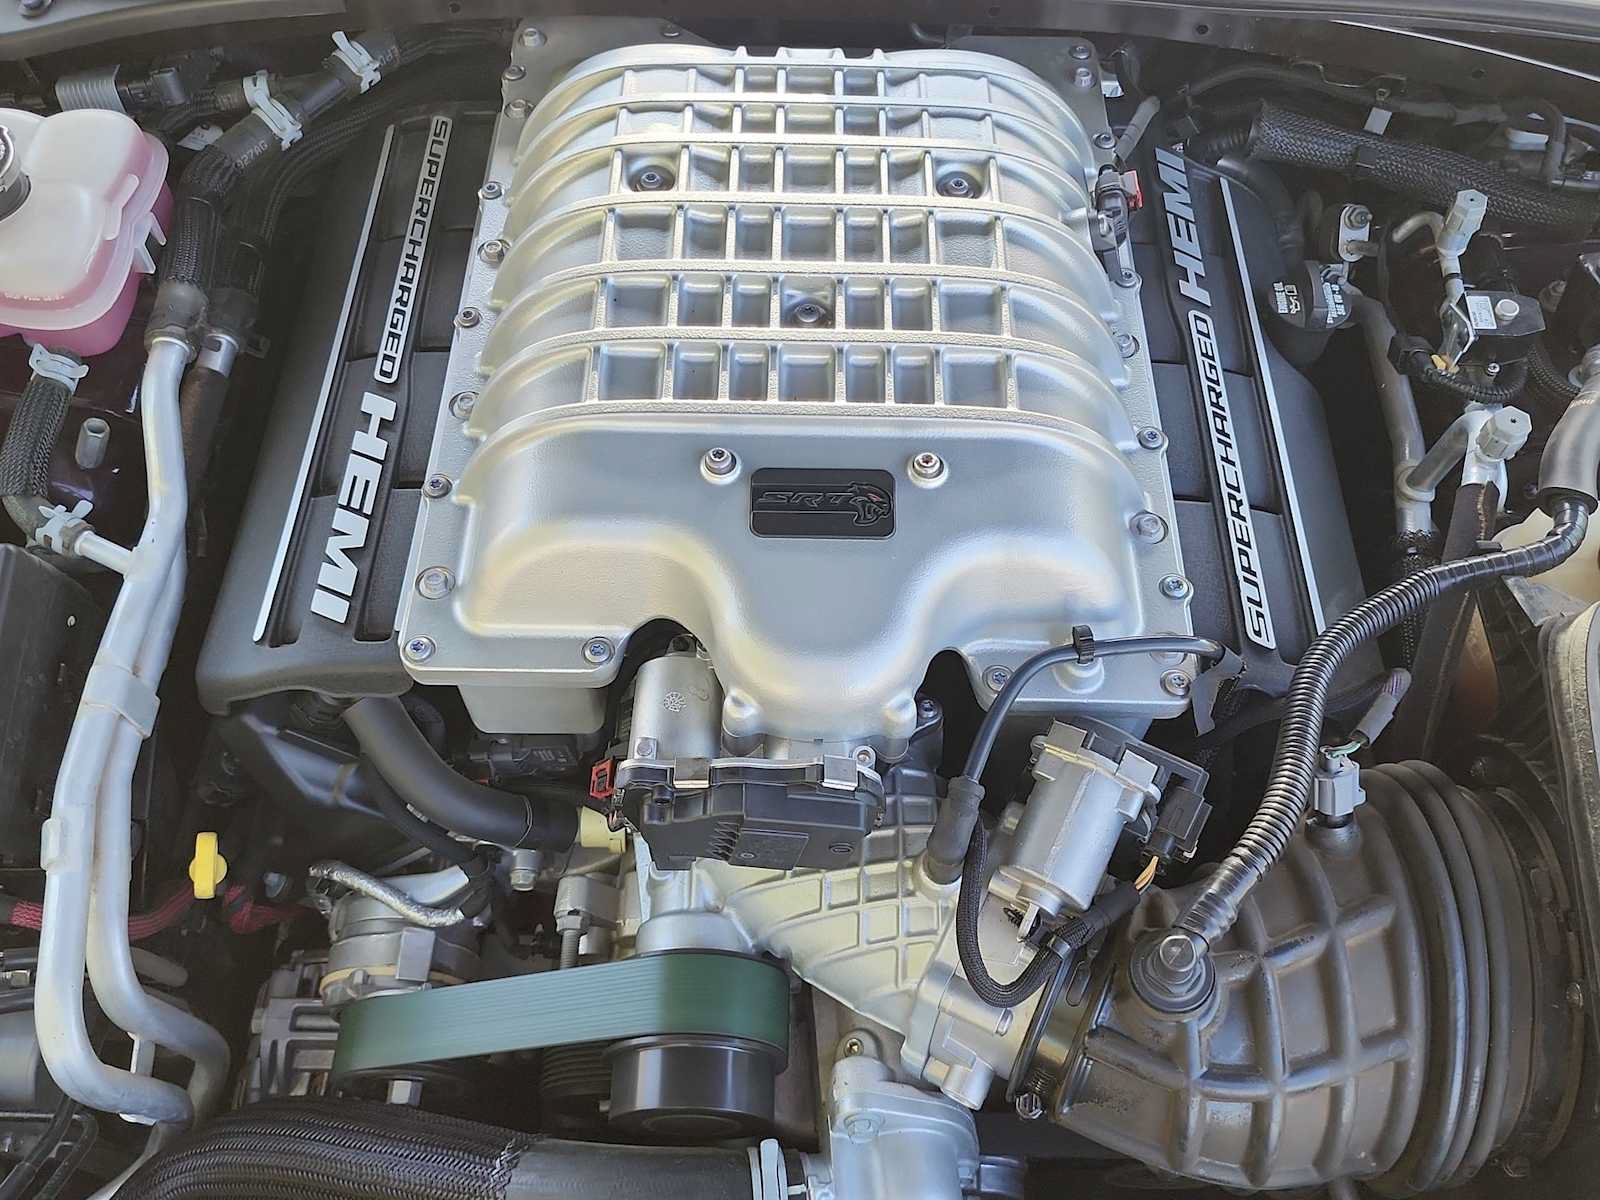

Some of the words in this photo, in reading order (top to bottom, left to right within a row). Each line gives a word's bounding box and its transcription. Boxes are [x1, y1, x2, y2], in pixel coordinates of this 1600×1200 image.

[378, 117, 450, 380] SUPERCHARGED
[1155, 147, 1212, 307] HEMI
[311, 391, 397, 624] HEMI
[757, 491, 854, 508] SRT
[1191, 312, 1272, 645] SUPERCHARGED
